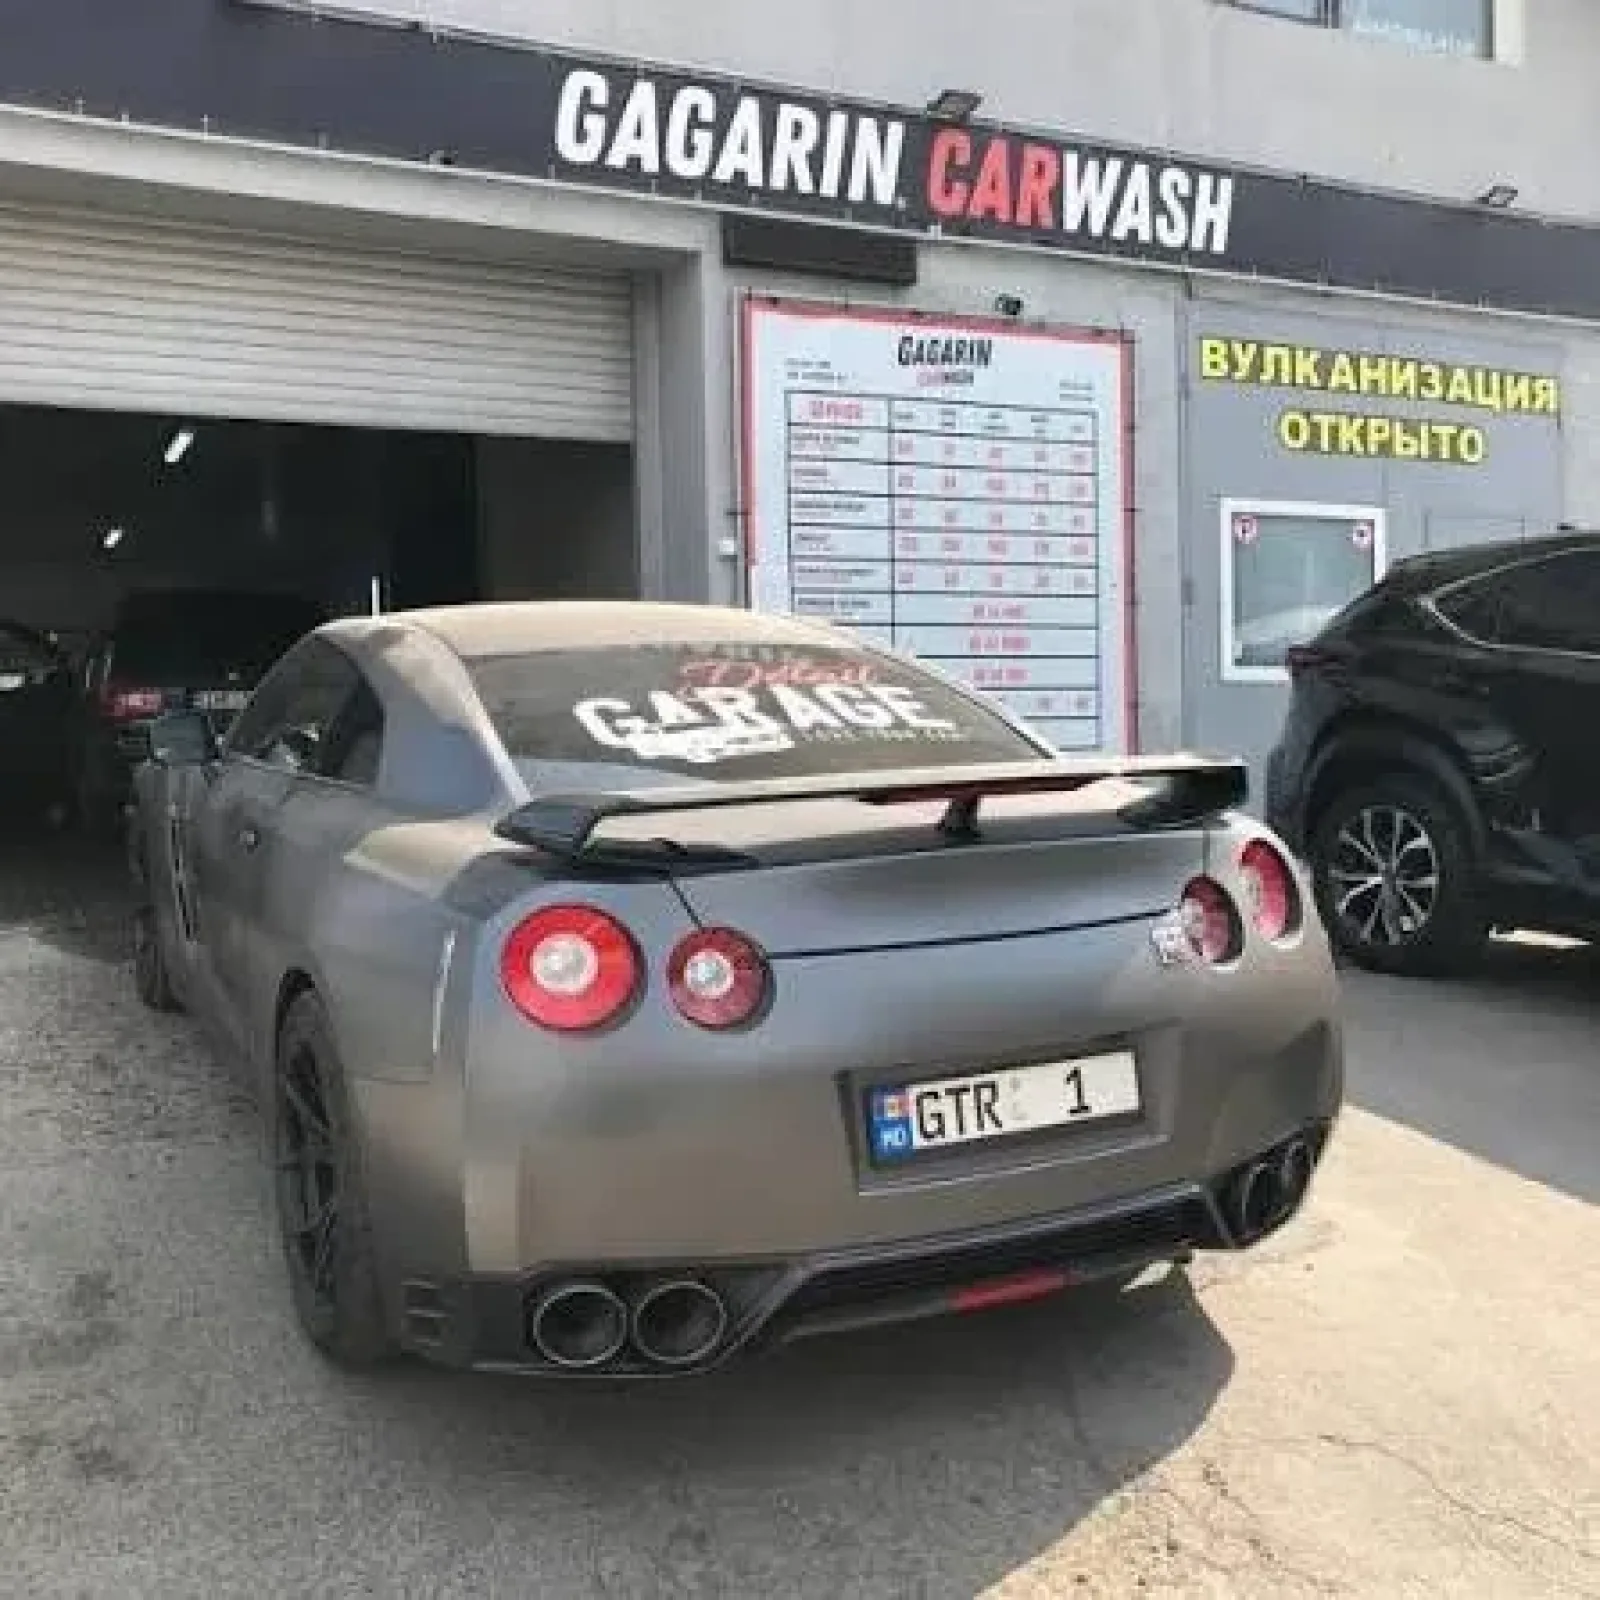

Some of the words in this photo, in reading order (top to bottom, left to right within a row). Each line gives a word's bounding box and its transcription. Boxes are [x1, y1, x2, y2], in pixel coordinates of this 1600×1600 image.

[555, 68, 903, 205] GAGARIN
[929, 128, 1232, 254] CARWASH
[1279, 410, 1485, 463] ОТКРЫТО
[572, 684, 956, 748] GARAGE
[915, 1080, 1003, 1139] GTR
[1065, 1066, 1092, 1114] 1
